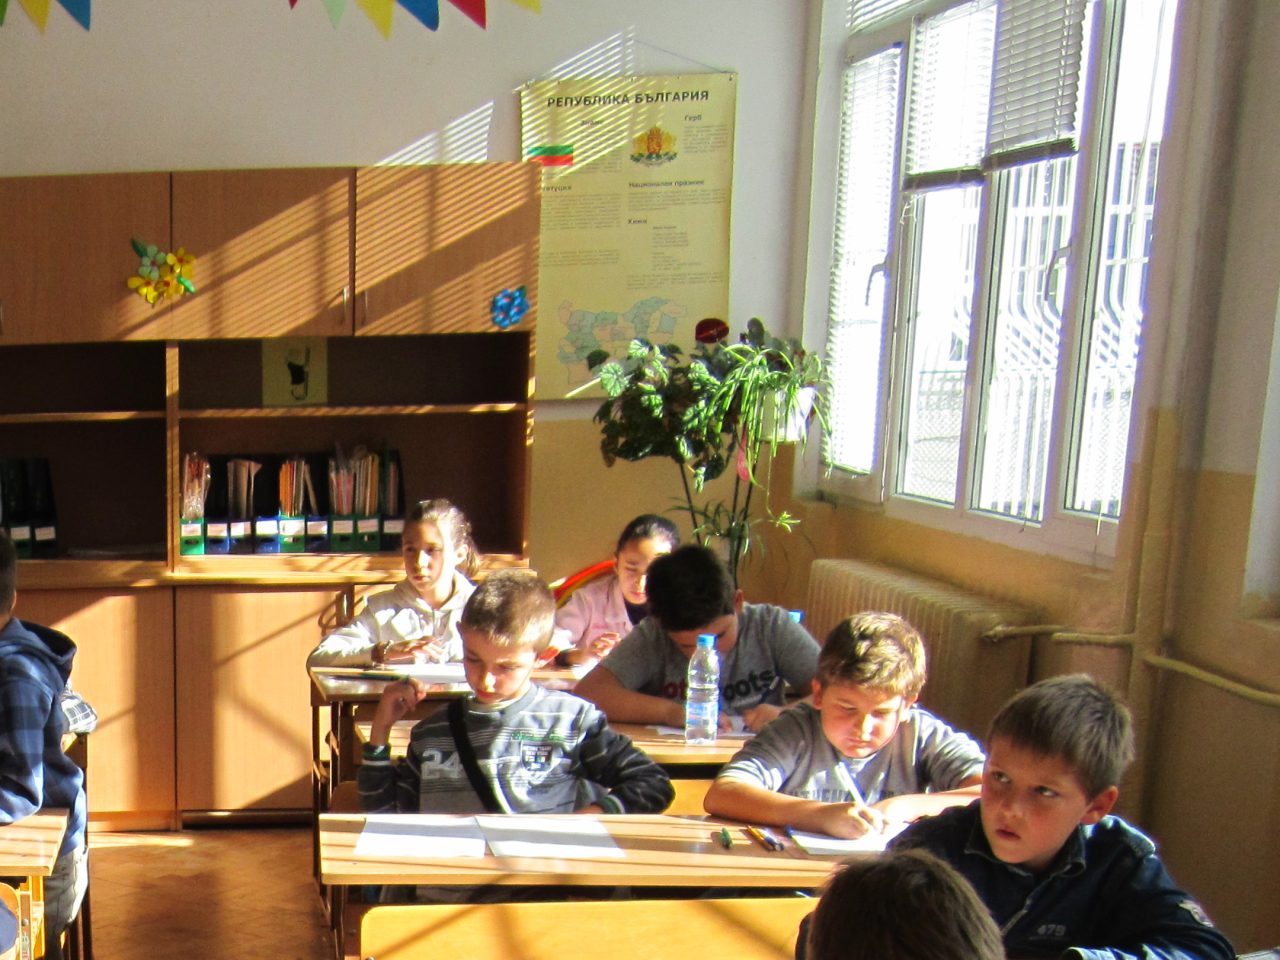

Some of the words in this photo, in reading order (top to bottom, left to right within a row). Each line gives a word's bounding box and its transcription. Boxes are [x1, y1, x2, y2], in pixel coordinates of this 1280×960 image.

[547, 94, 630, 107] РЕПУБЛИКА
[635, 91, 709, 103] БЪЛГАРИЯ
[422, 749, 462, 780] 24
